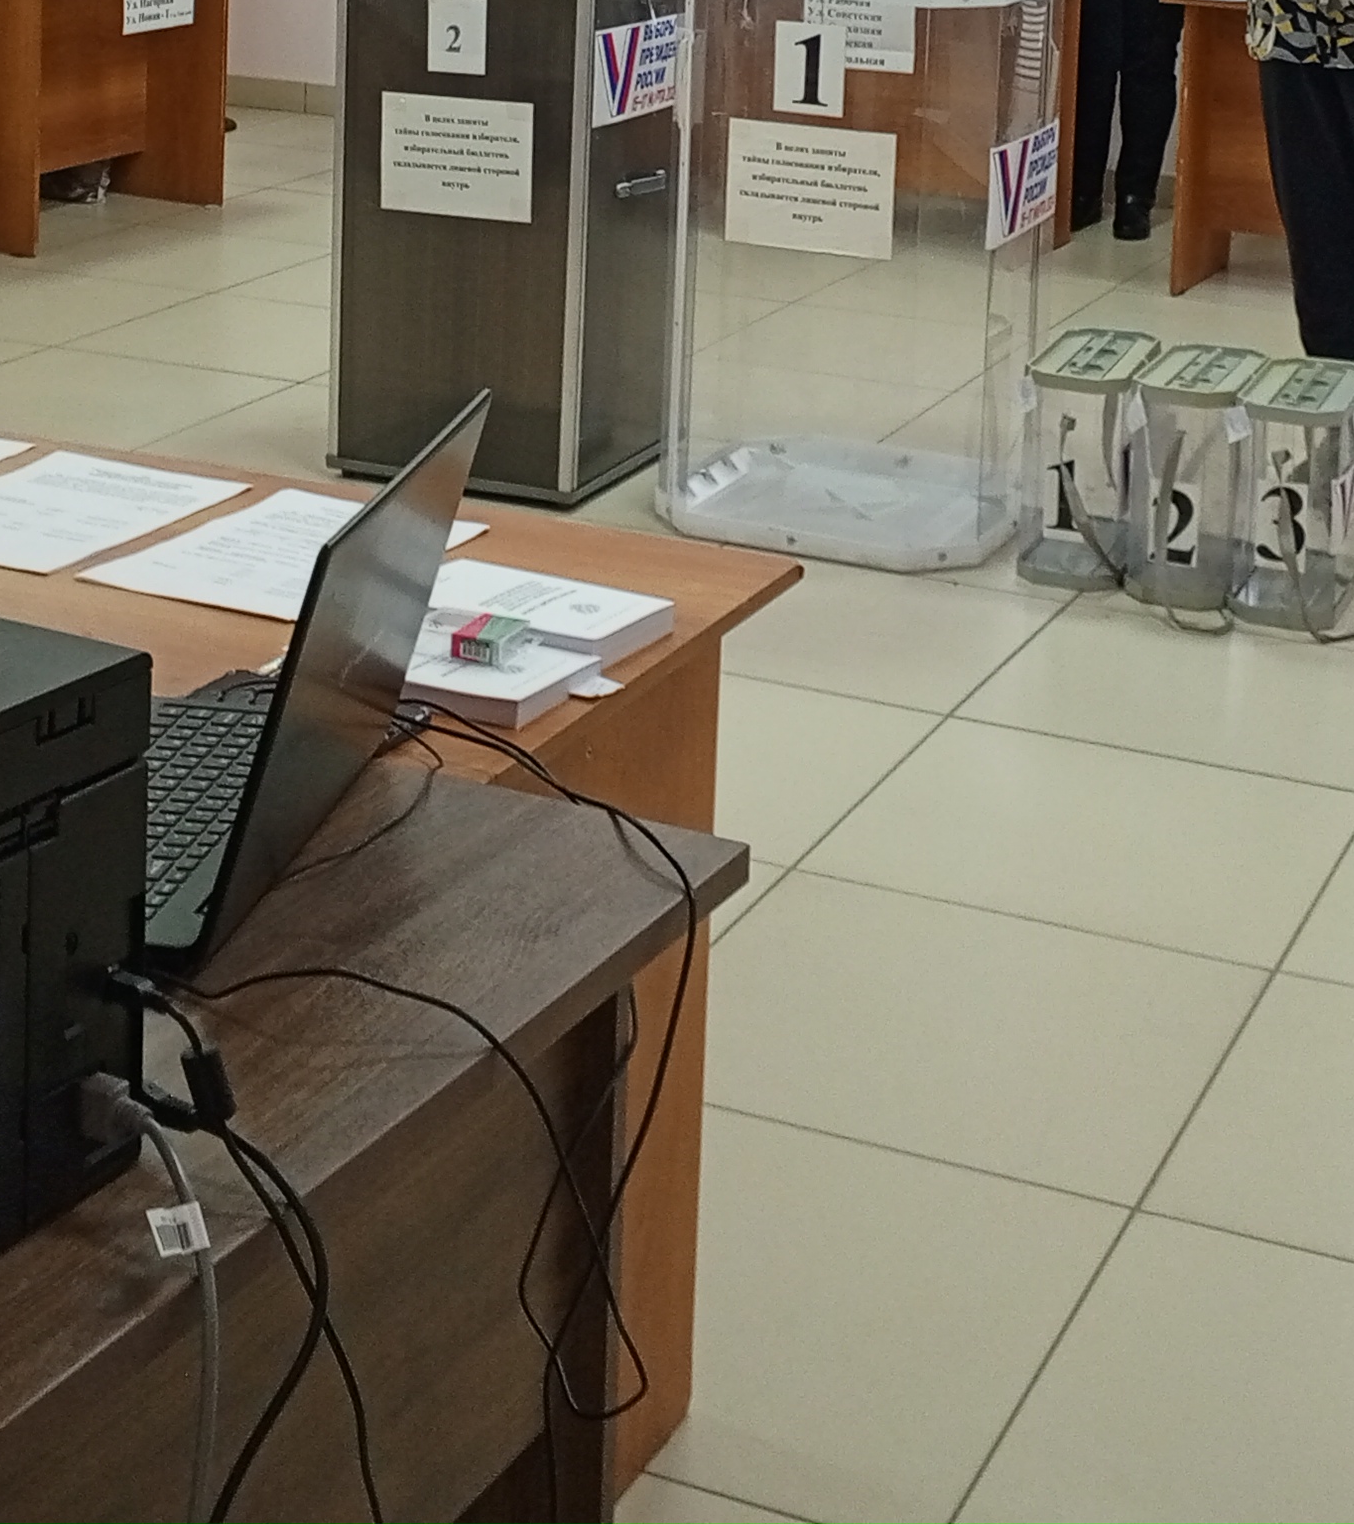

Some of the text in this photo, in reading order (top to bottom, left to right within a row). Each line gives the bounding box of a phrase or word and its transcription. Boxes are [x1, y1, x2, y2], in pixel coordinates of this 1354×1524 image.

[445, 25, 462, 53] 2
[792, 33, 828, 107] 1
[1046, 459, 1078, 531] 1
[1150, 487, 1197, 565] 2
[1256, 485, 1307, 561] 3
